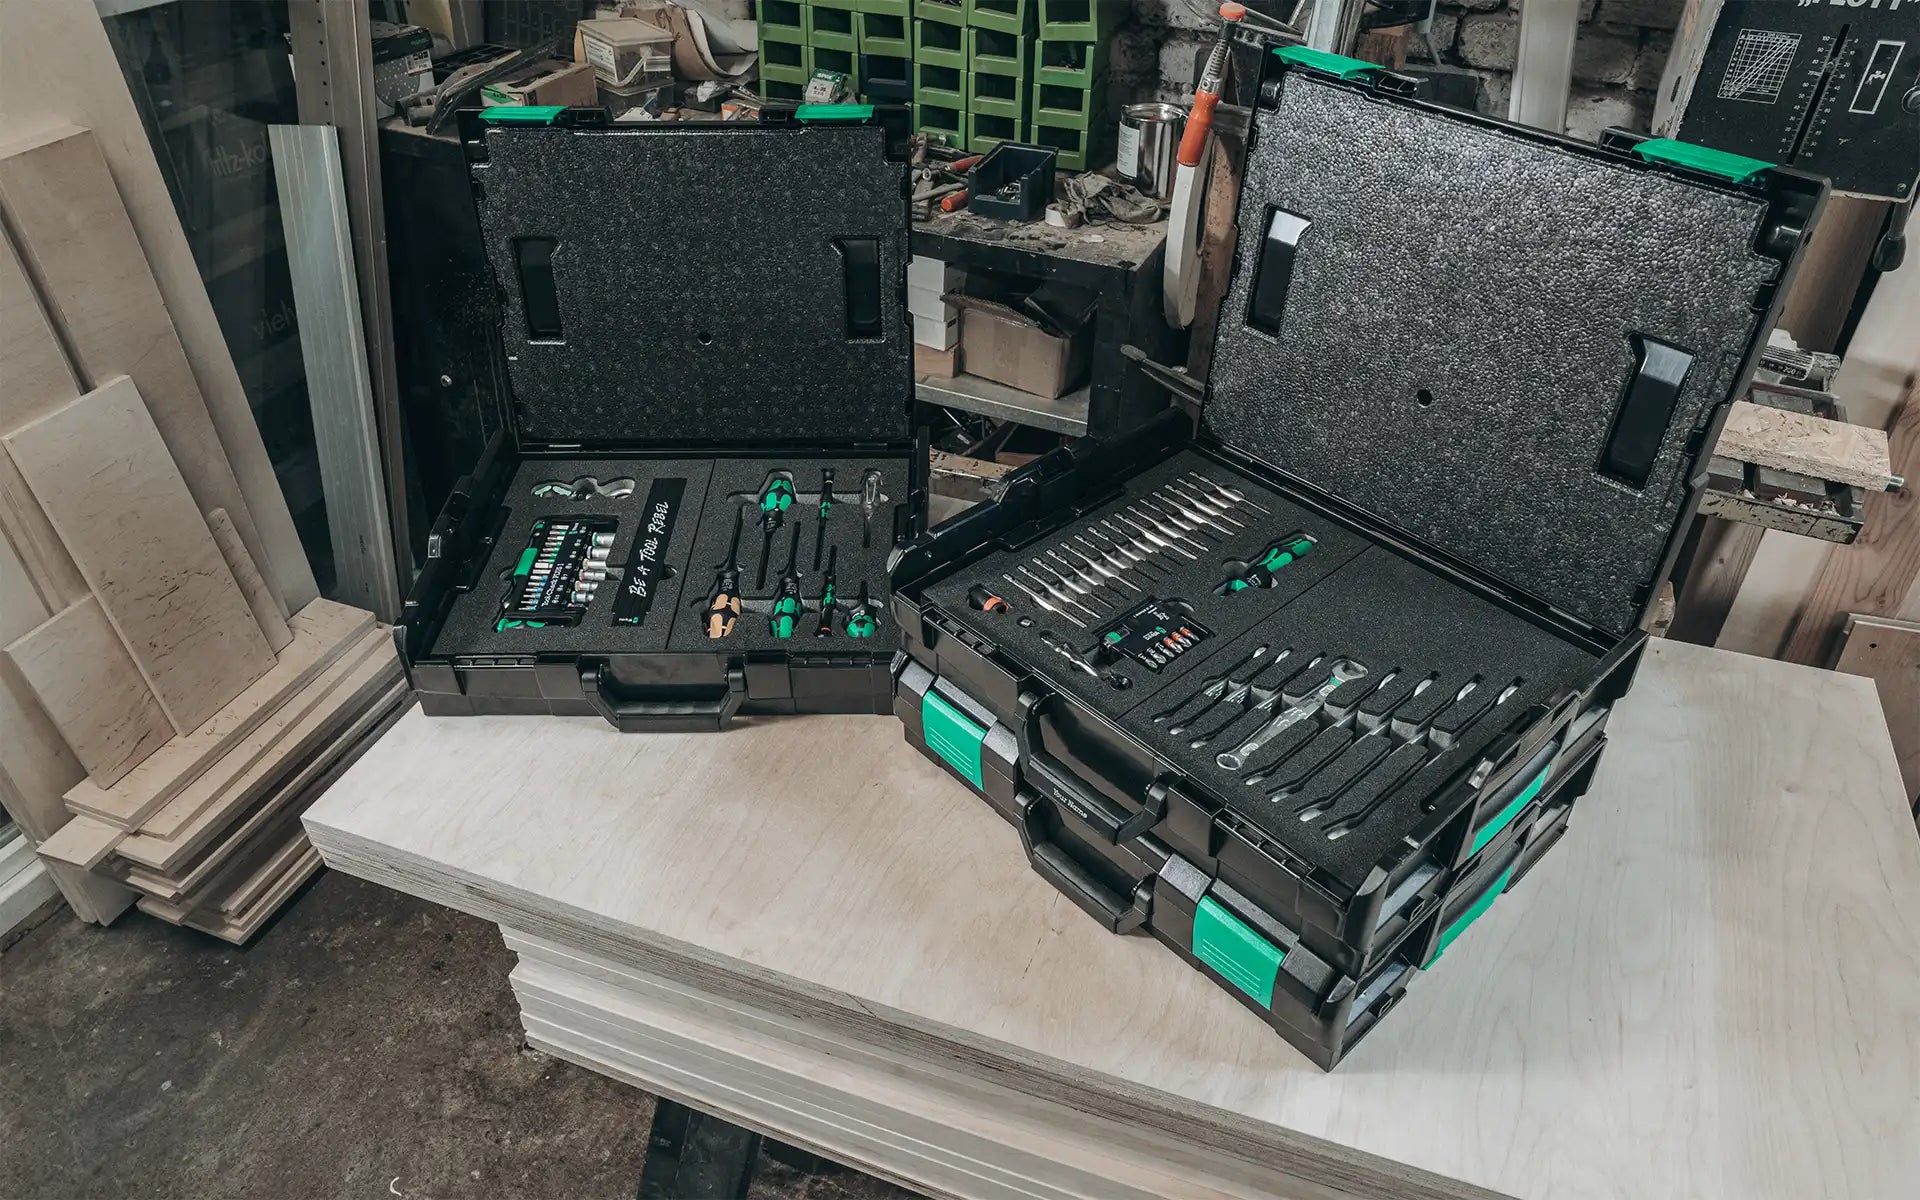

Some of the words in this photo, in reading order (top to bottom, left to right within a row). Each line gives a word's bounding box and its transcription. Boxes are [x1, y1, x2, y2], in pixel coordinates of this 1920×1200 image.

[647, 501, 669, 535] REBEL
[639, 537, 659, 562] TOOL
[637, 564, 651, 576] A
[628, 576, 647, 598] BE
[1053, 787, 1068, 804] Your
[1067, 799, 1088, 819] Name
